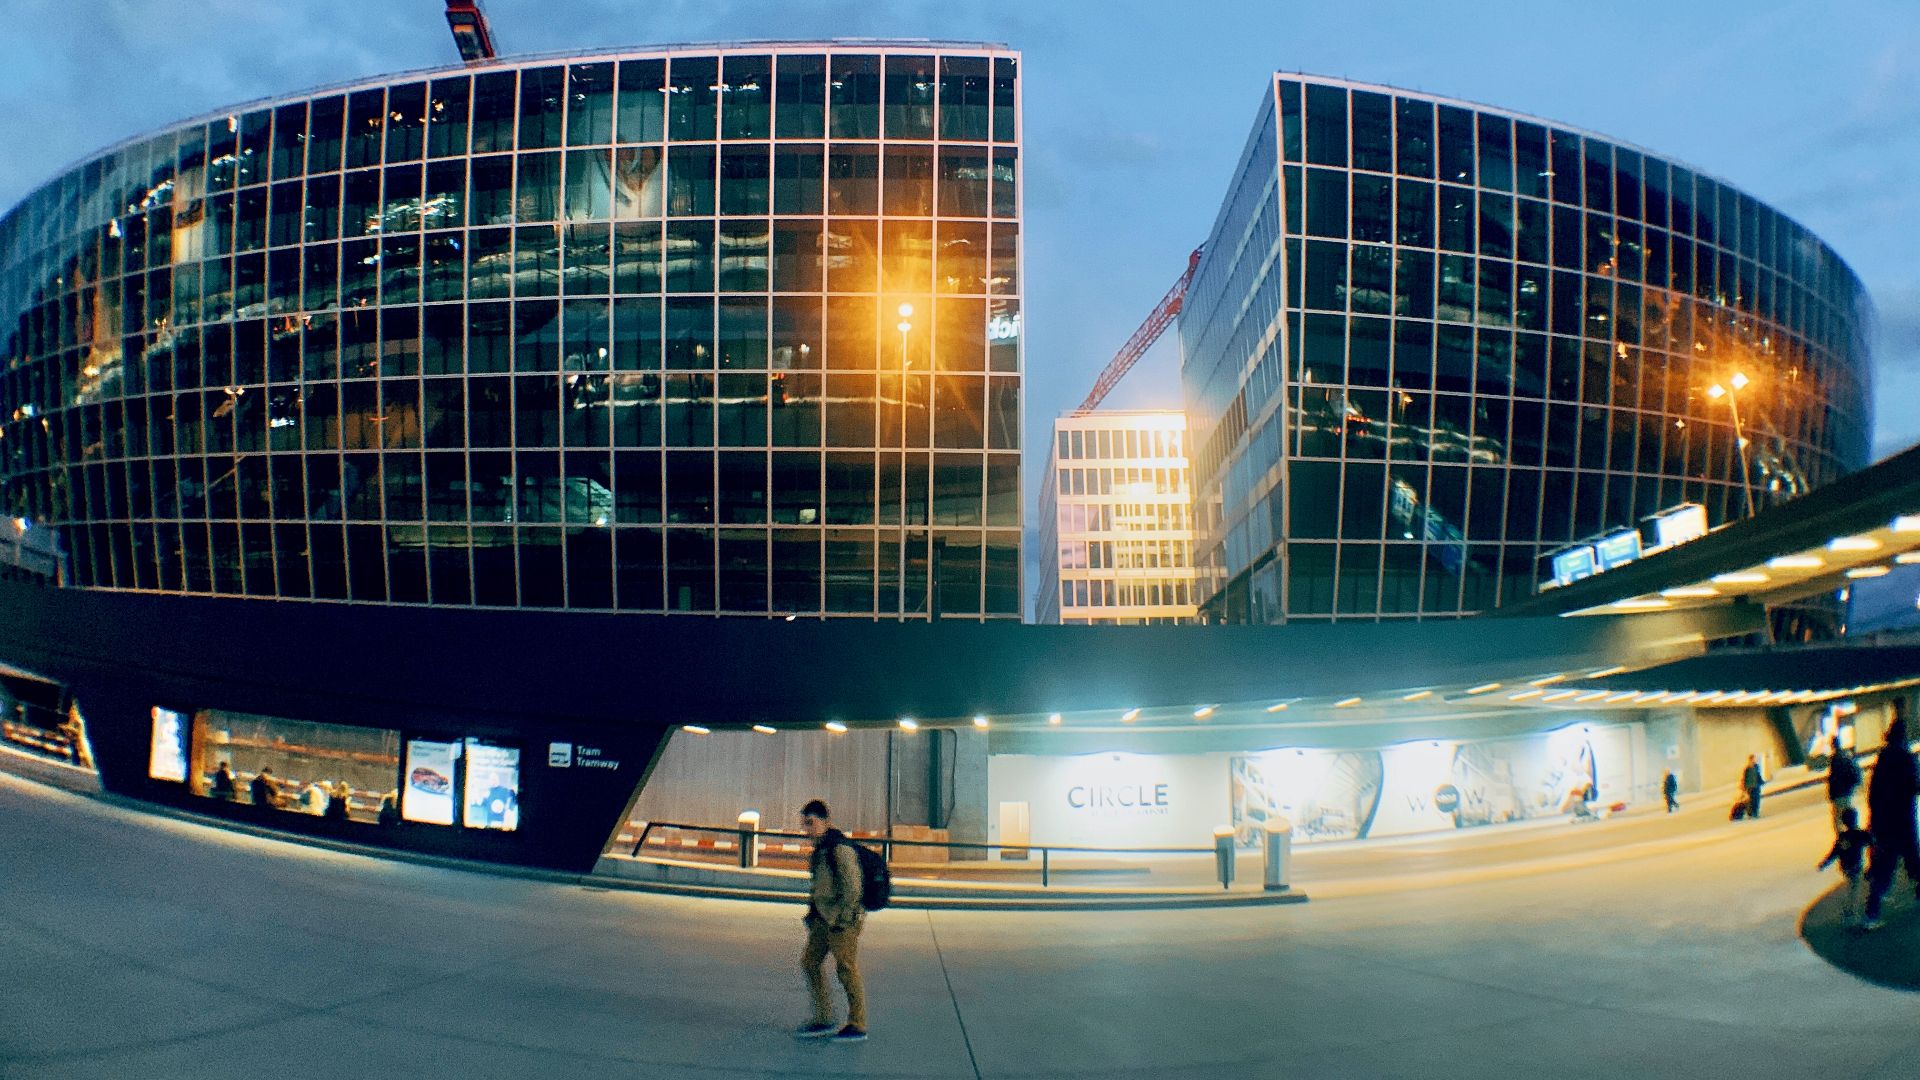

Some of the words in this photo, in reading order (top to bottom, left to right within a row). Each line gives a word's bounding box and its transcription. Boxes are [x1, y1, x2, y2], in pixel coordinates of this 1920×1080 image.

[577, 745, 601, 756] Tram
[577, 757, 619, 771] Tramway
[1067, 784, 1168, 809] CIRCLE
